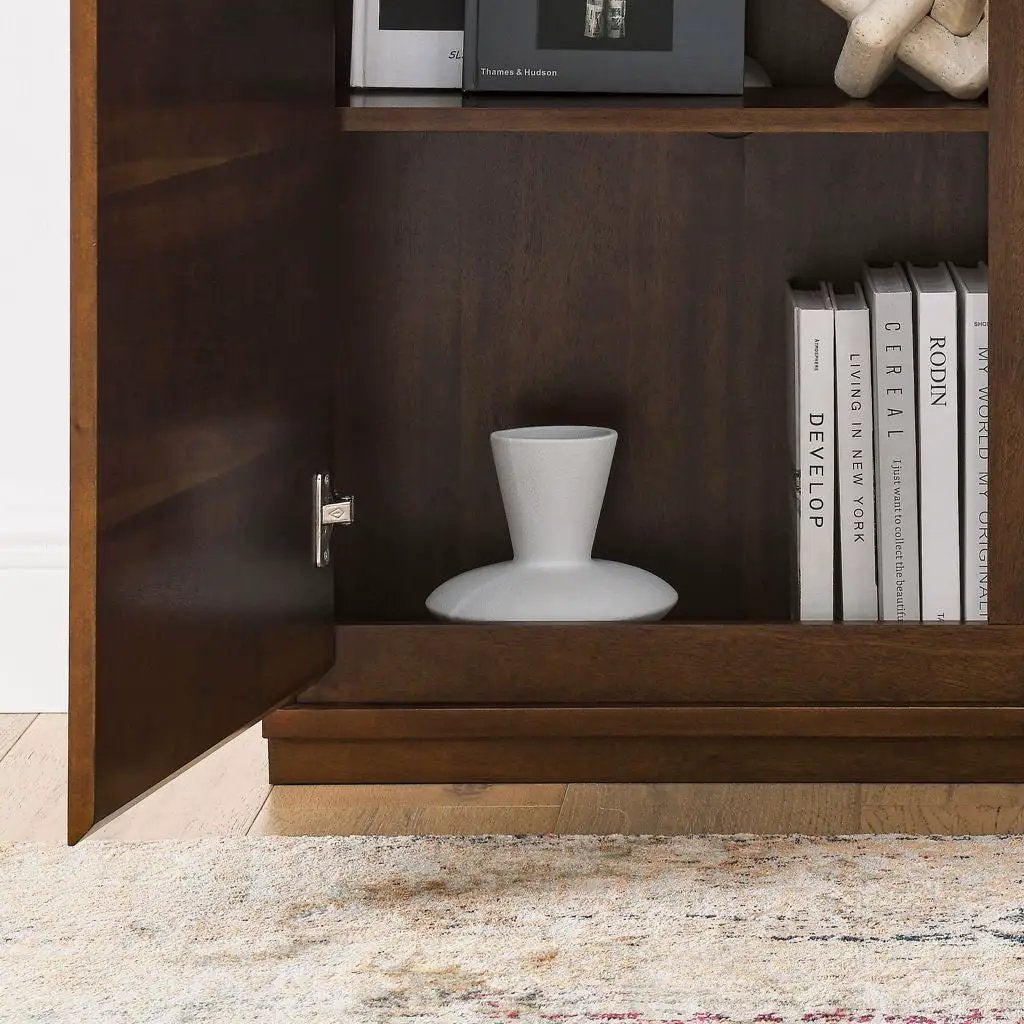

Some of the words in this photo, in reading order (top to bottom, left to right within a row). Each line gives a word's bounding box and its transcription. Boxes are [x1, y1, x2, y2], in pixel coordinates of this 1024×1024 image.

[448, 51, 464, 60] SL
[480, 67, 515, 76] Thames
[516, 68, 523, 76] &
[524, 68, 557, 77] Hudson
[929, 336, 947, 407] RODIN
[978, 347, 989, 373] MY
[849, 354, 862, 411] LIVING
[884, 322, 904, 438] CEREAL
[851, 422, 862, 438] IN
[978, 386, 989, 460] WORLD
[809, 413, 824, 528] DEVELOP
[852, 450, 864, 486] NEW
[891, 465, 902, 485] just
[978, 472, 989, 497] MY
[893, 487, 902, 512] want
[853, 496, 865, 543] YORK
[894, 514, 903, 525] to
[895, 526, 905, 559] collect
[895, 560, 905, 578] the
